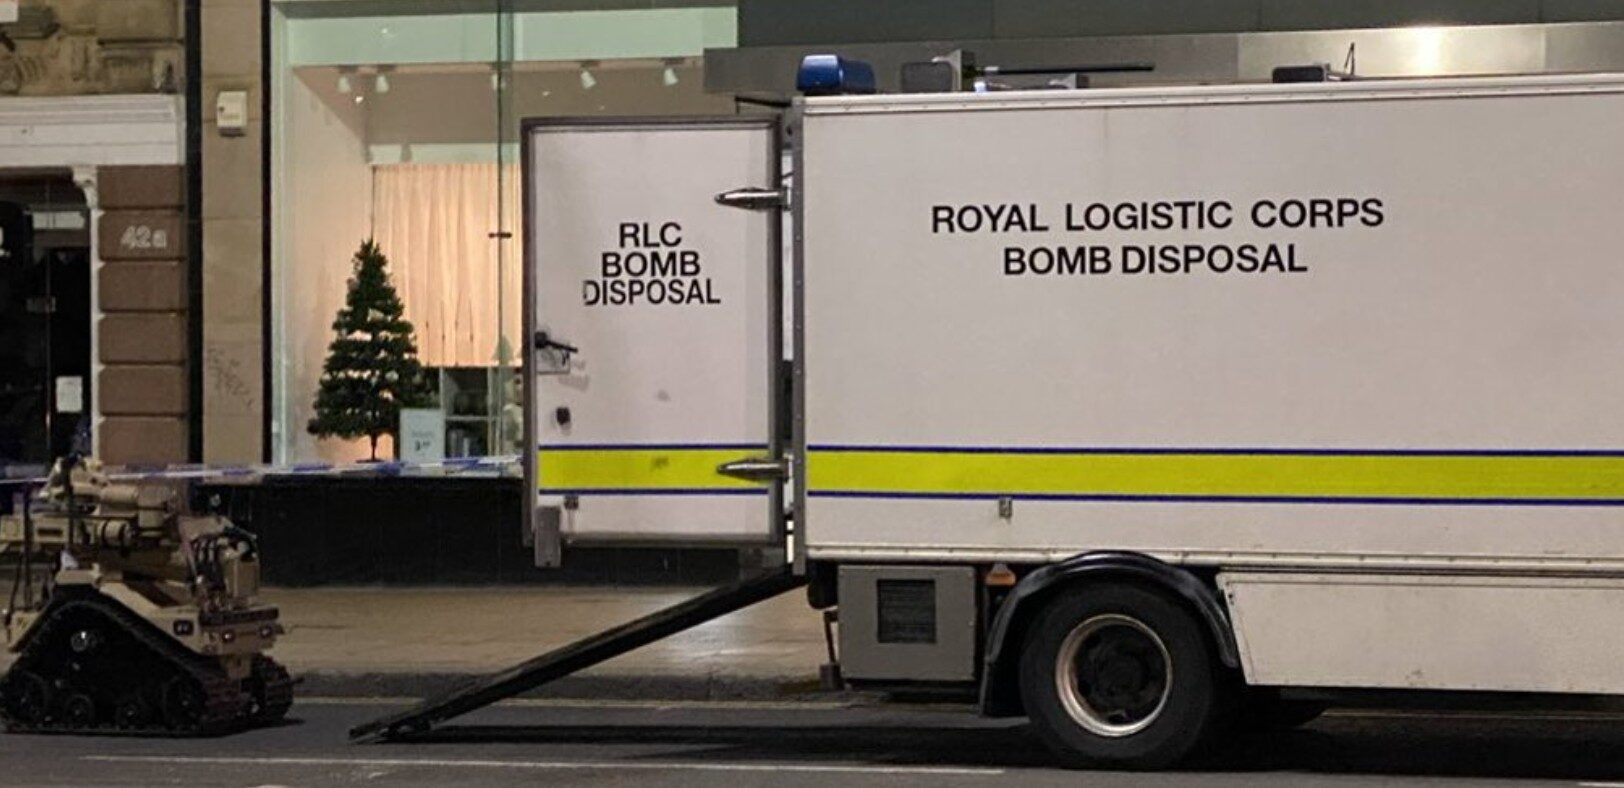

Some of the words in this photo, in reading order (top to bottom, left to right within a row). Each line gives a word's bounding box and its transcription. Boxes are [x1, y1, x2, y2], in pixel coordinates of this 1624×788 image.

[932, 203, 1049, 233] ROYAL
[1066, 199, 1233, 231] LOGISTIC
[1251, 198, 1384, 228] CORPS
[121, 225, 167, 250] 42a
[619, 221, 682, 248] RLC
[602, 250, 701, 278] BOMB
[1004, 246, 1112, 275] BOMB
[1121, 243, 1308, 274] DISPOSAL
[583, 278, 721, 306] DISPOSAL
